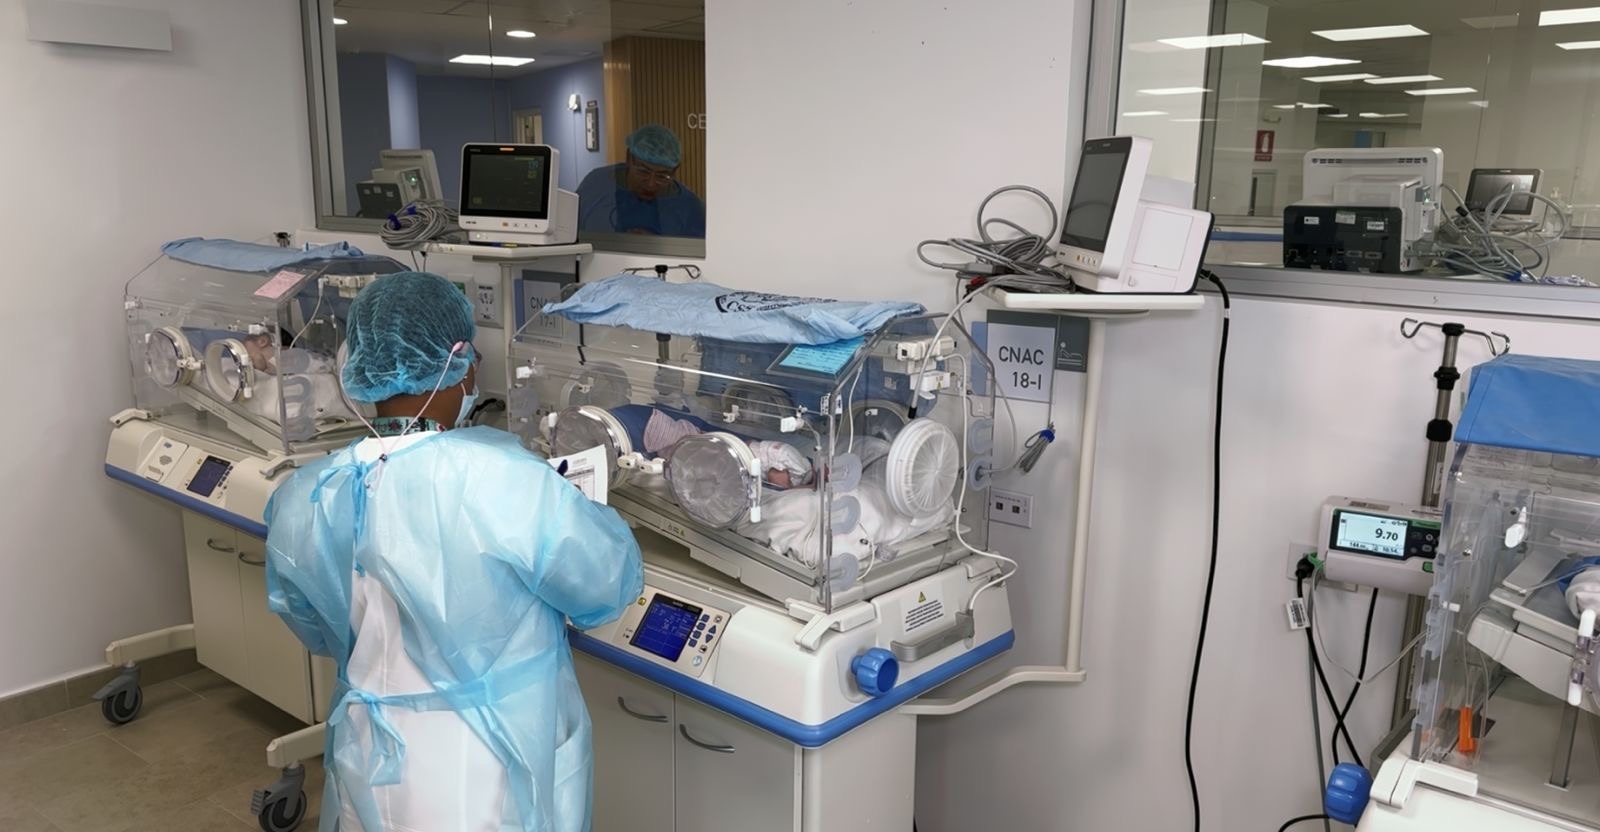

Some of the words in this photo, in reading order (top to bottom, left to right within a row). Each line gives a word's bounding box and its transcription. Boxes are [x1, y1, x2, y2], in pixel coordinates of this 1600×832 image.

[998, 345, 1044, 366] CNAC
[1012, 371, 1042, 390] 18-I
[1375, 527, 1399, 542] 9.70
